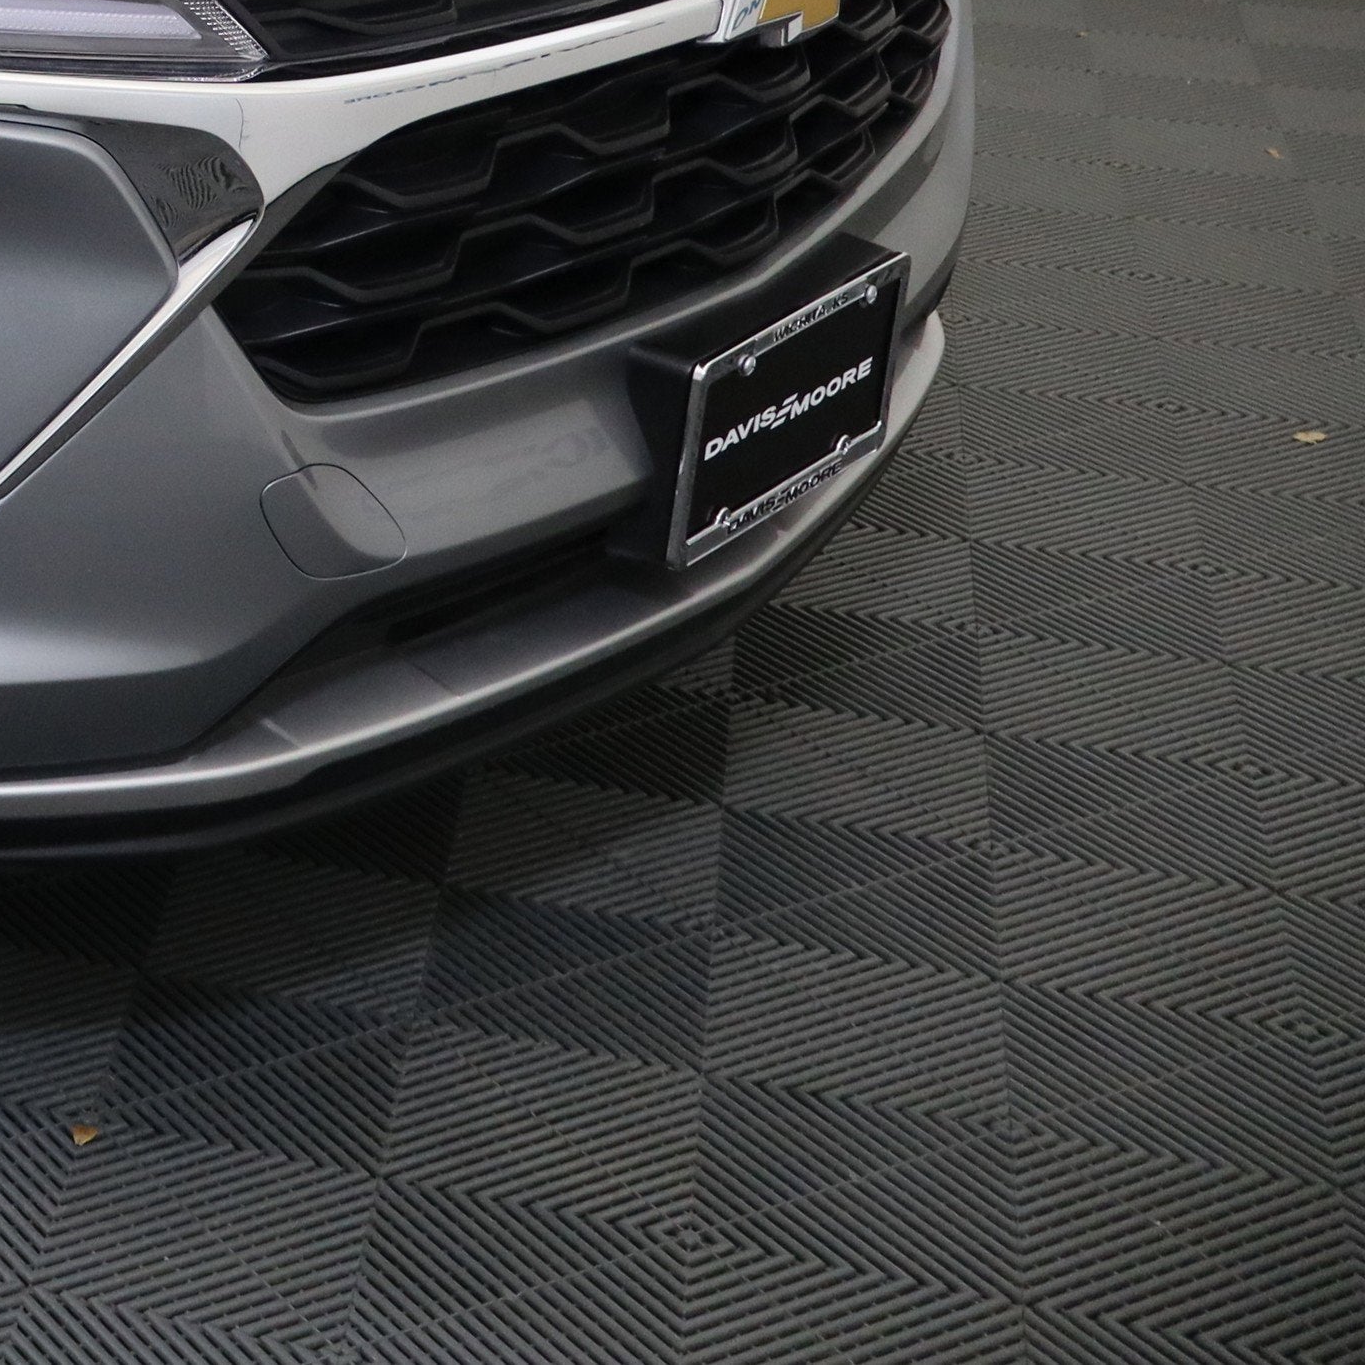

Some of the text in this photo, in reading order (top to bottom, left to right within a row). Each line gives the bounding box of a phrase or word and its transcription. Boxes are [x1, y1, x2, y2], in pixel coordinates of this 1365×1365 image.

[704, 356, 874, 461] DAVIS MOORE
[785, 460, 844, 505] MOORE
